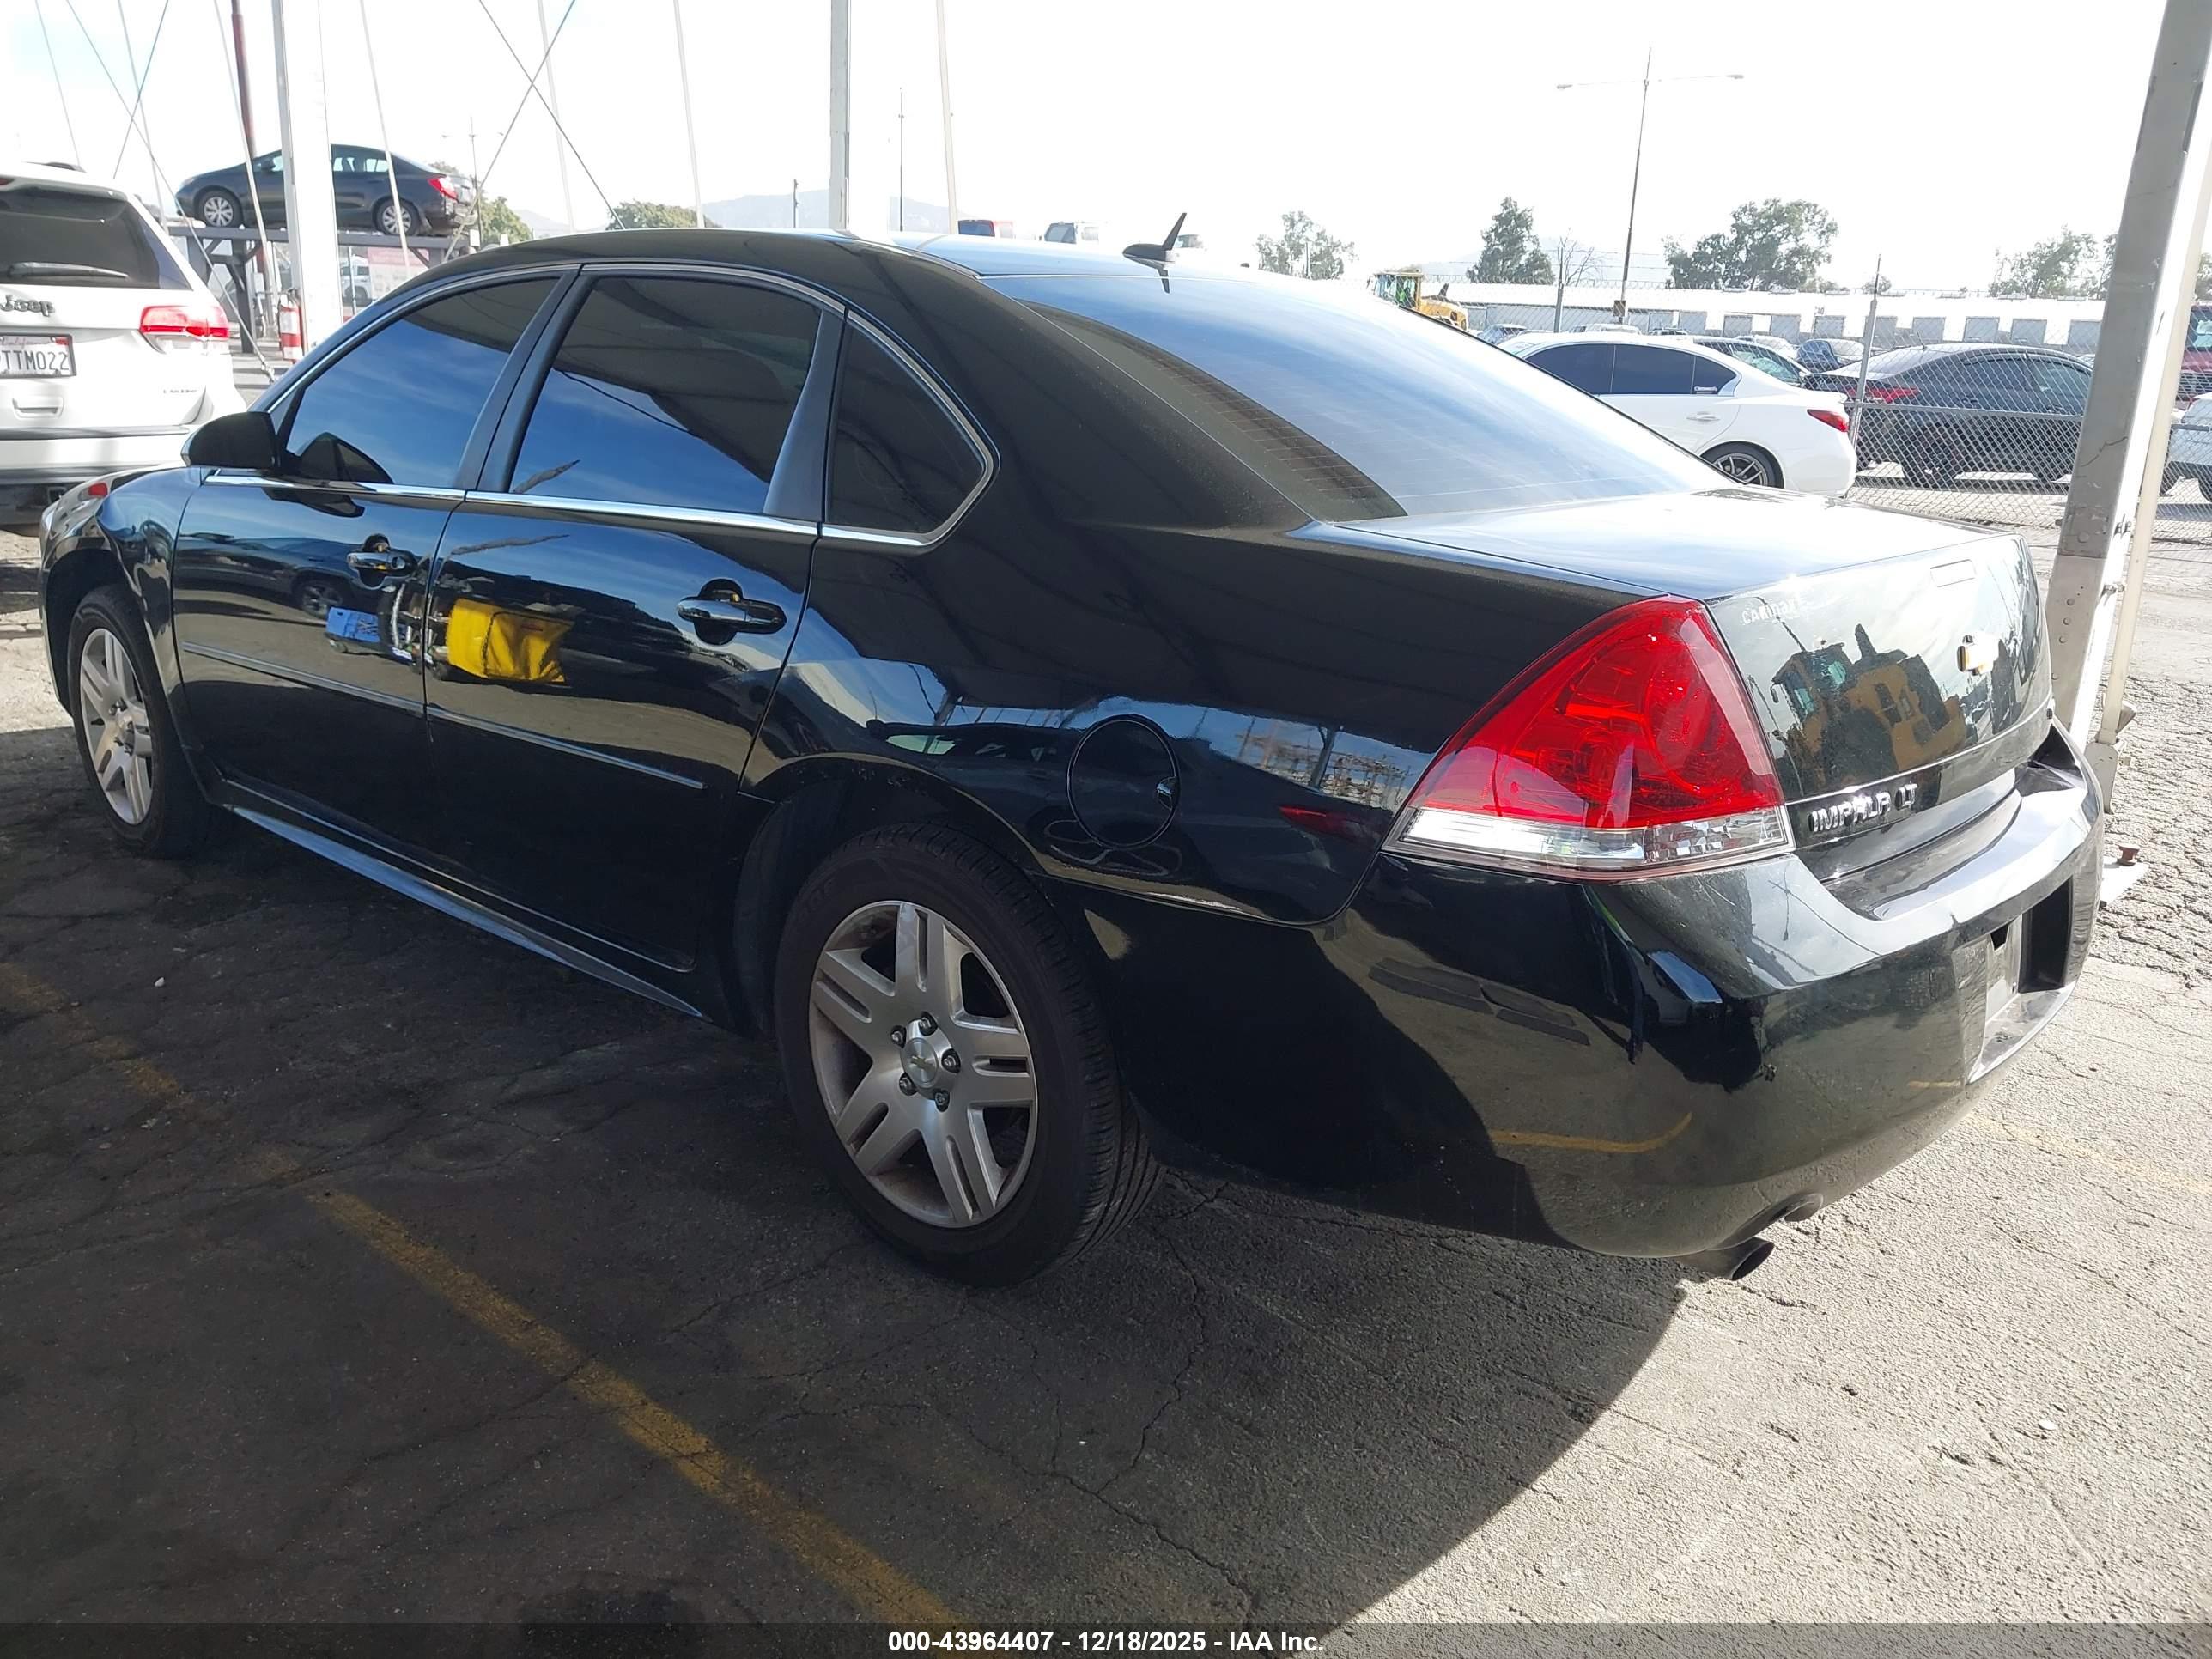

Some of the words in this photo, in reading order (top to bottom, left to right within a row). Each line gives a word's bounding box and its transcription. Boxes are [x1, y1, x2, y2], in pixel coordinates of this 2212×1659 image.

[0, 295, 56, 317] Jeep
[0, 349, 70, 370] TTM022
[1808, 792, 1891, 832] IMPALA
[1895, 783, 1917, 810] LT
